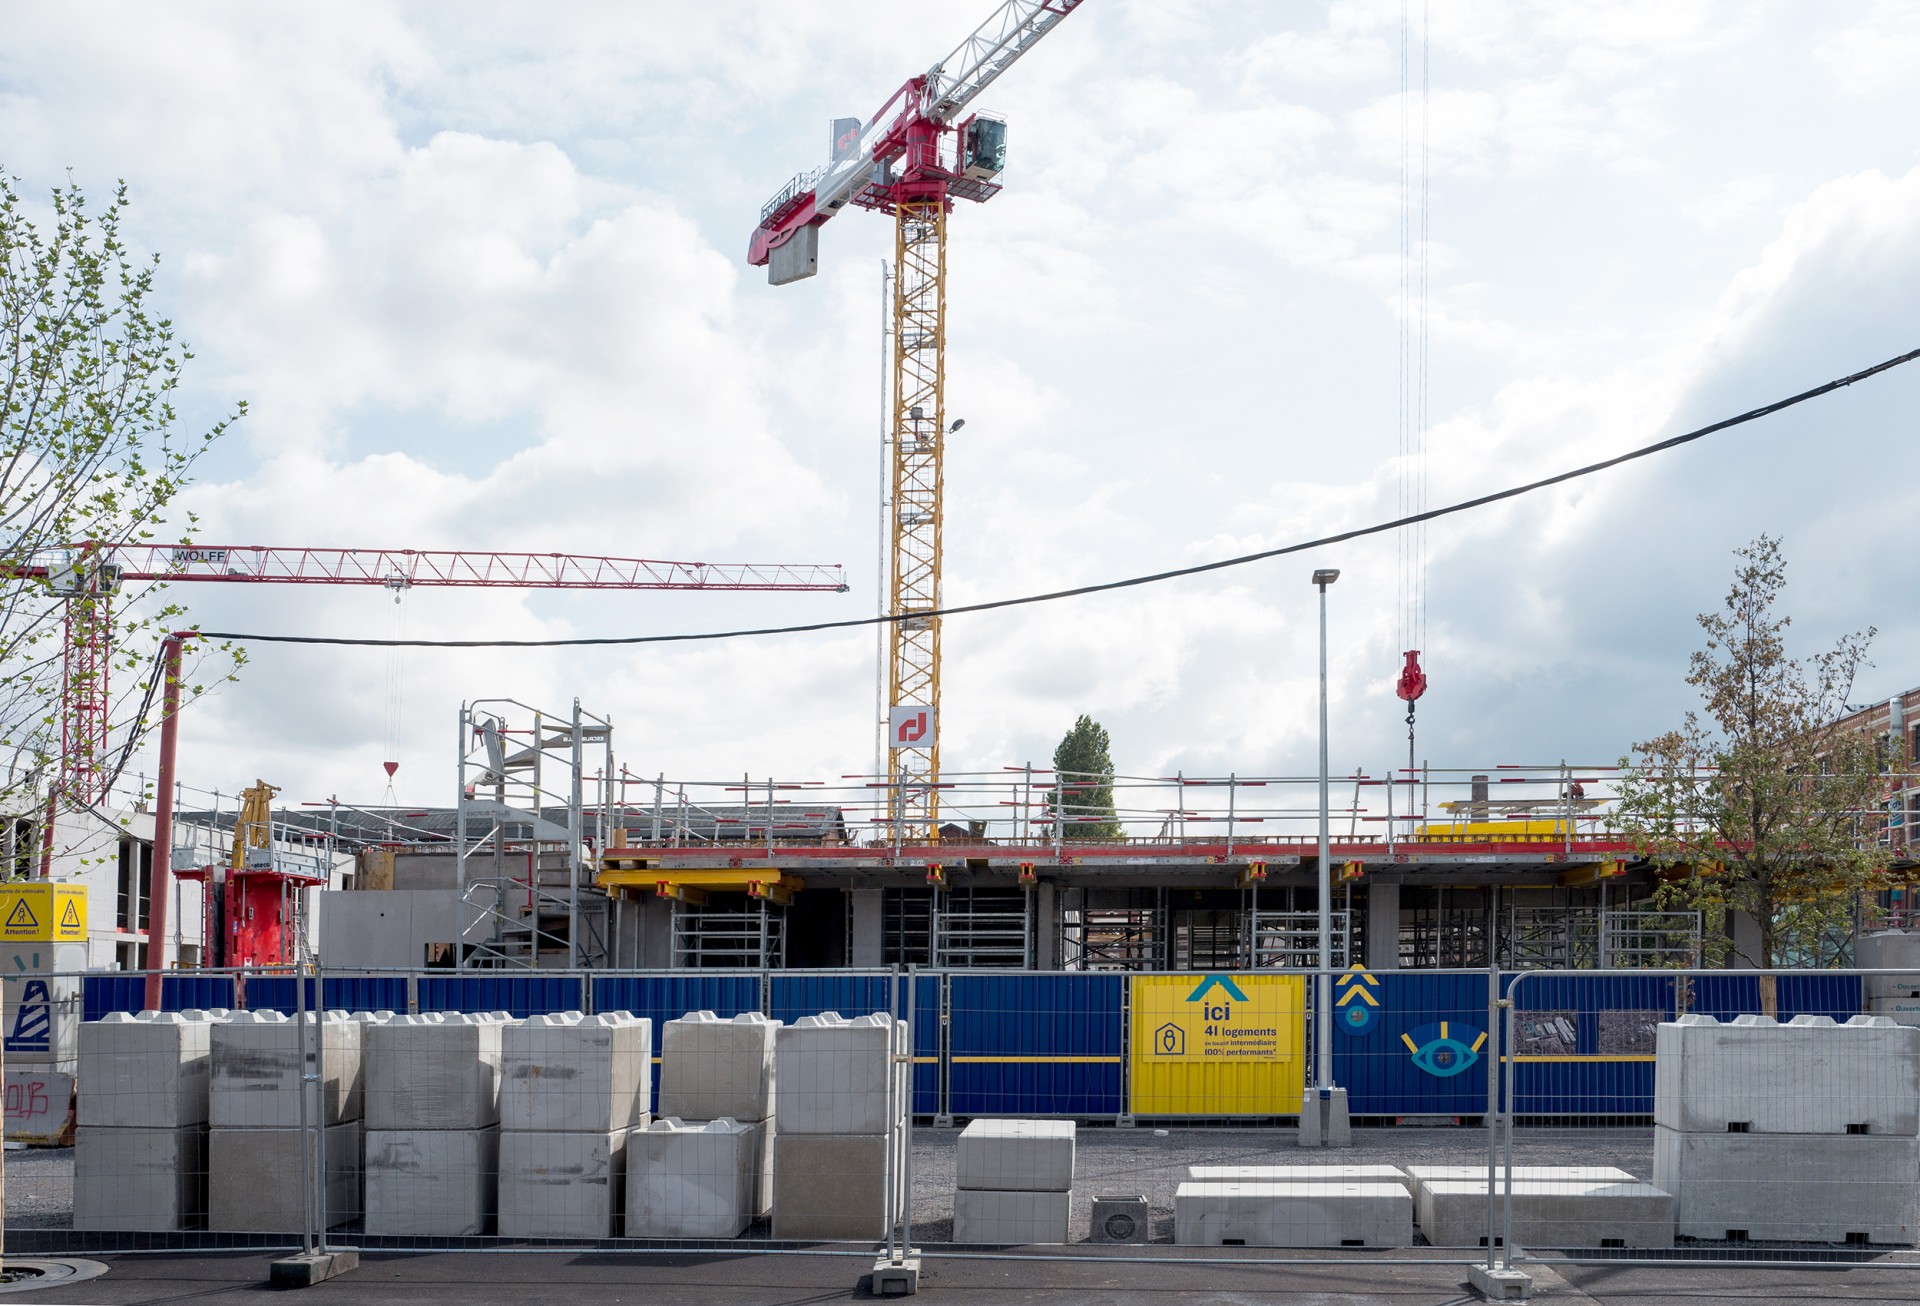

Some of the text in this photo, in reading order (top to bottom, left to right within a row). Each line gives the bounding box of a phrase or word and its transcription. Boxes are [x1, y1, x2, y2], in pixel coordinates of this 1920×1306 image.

[176, 551, 225, 561] WOLFF
[1204, 1002, 1230, 1020] ici
[1205, 1025, 1276, 1038] 41 logements
